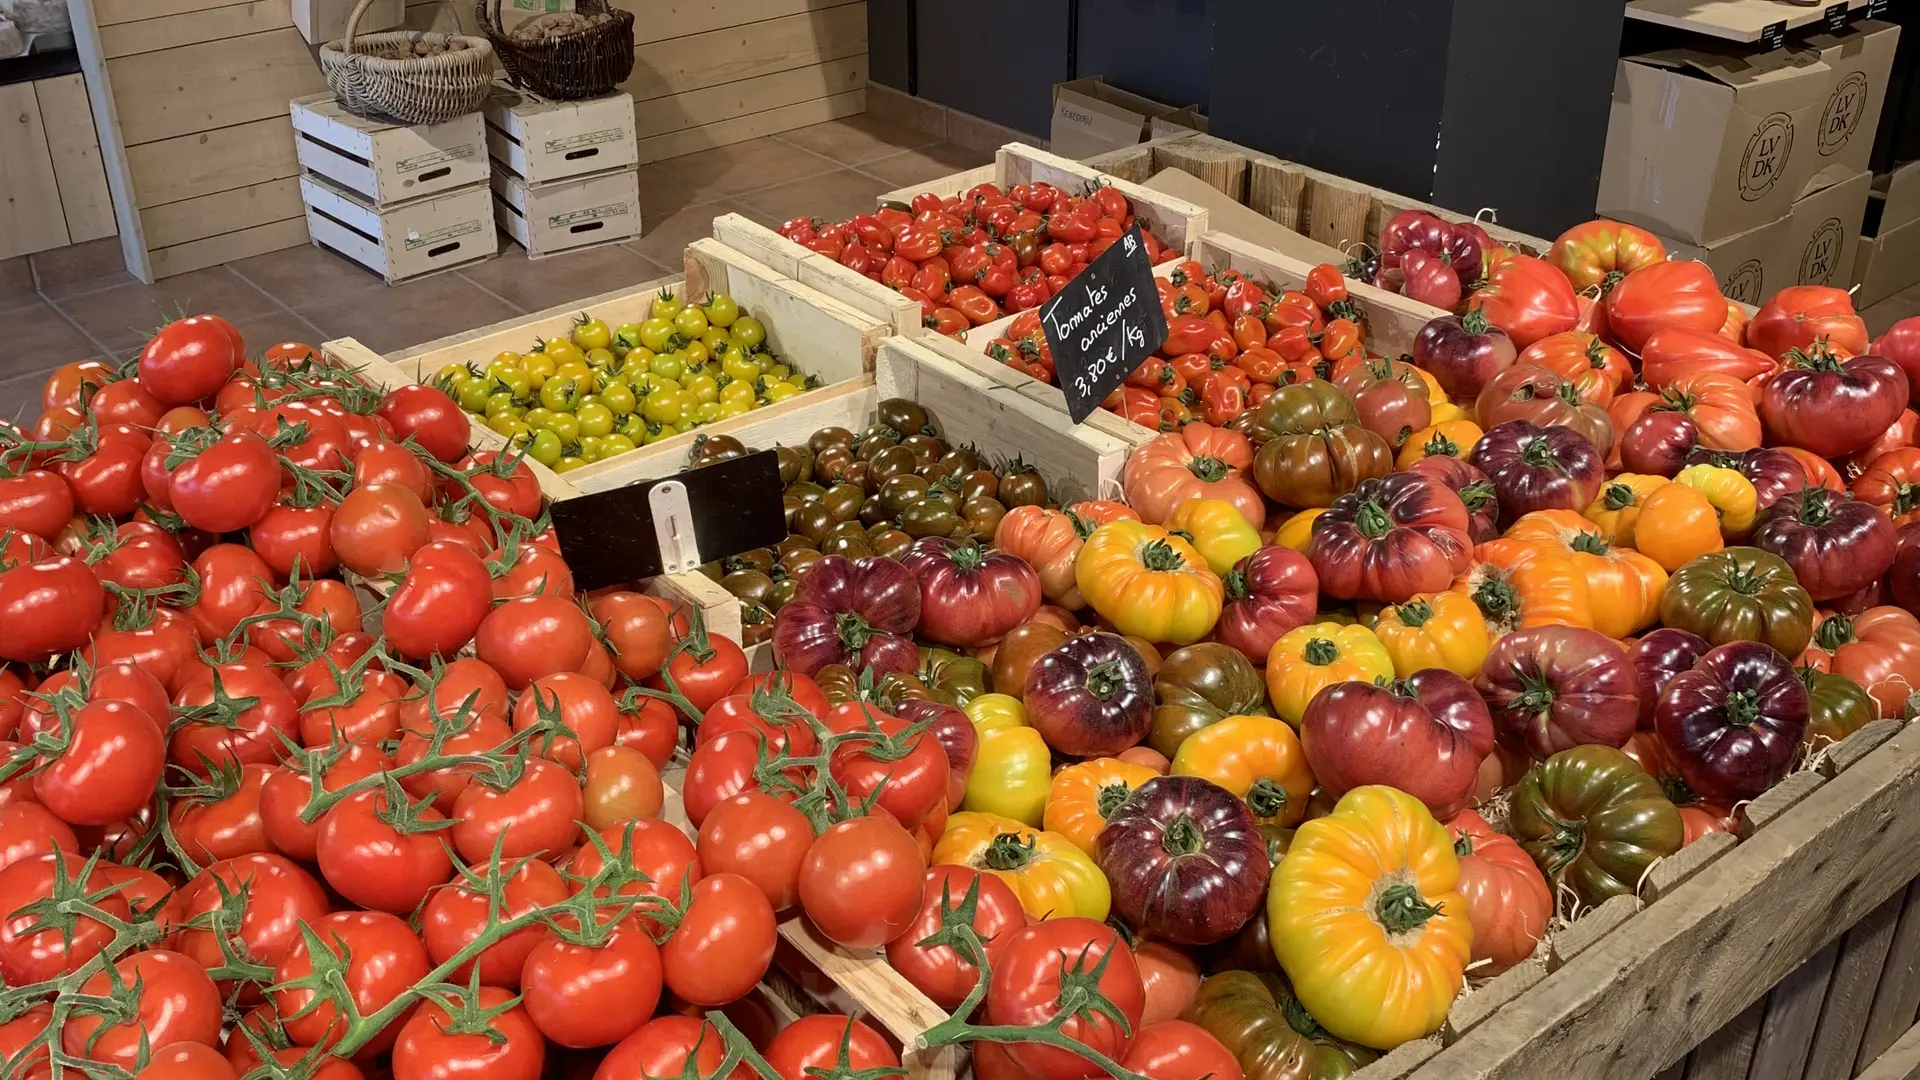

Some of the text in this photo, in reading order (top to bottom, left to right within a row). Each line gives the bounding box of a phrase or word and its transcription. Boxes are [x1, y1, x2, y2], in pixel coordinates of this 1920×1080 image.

[1835, 93, 1855, 115] LV
[1828, 112, 1850, 134] DK
[1759, 136, 1781, 157] LV
[1752, 156, 1776, 178] DK
[1123, 234, 1138, 251] AB
[1814, 238, 1832, 260] LV
[1809, 256, 1829, 279] DK
[1043, 285, 1108, 341] Tomates
[1081, 287, 1137, 351] anciennes
